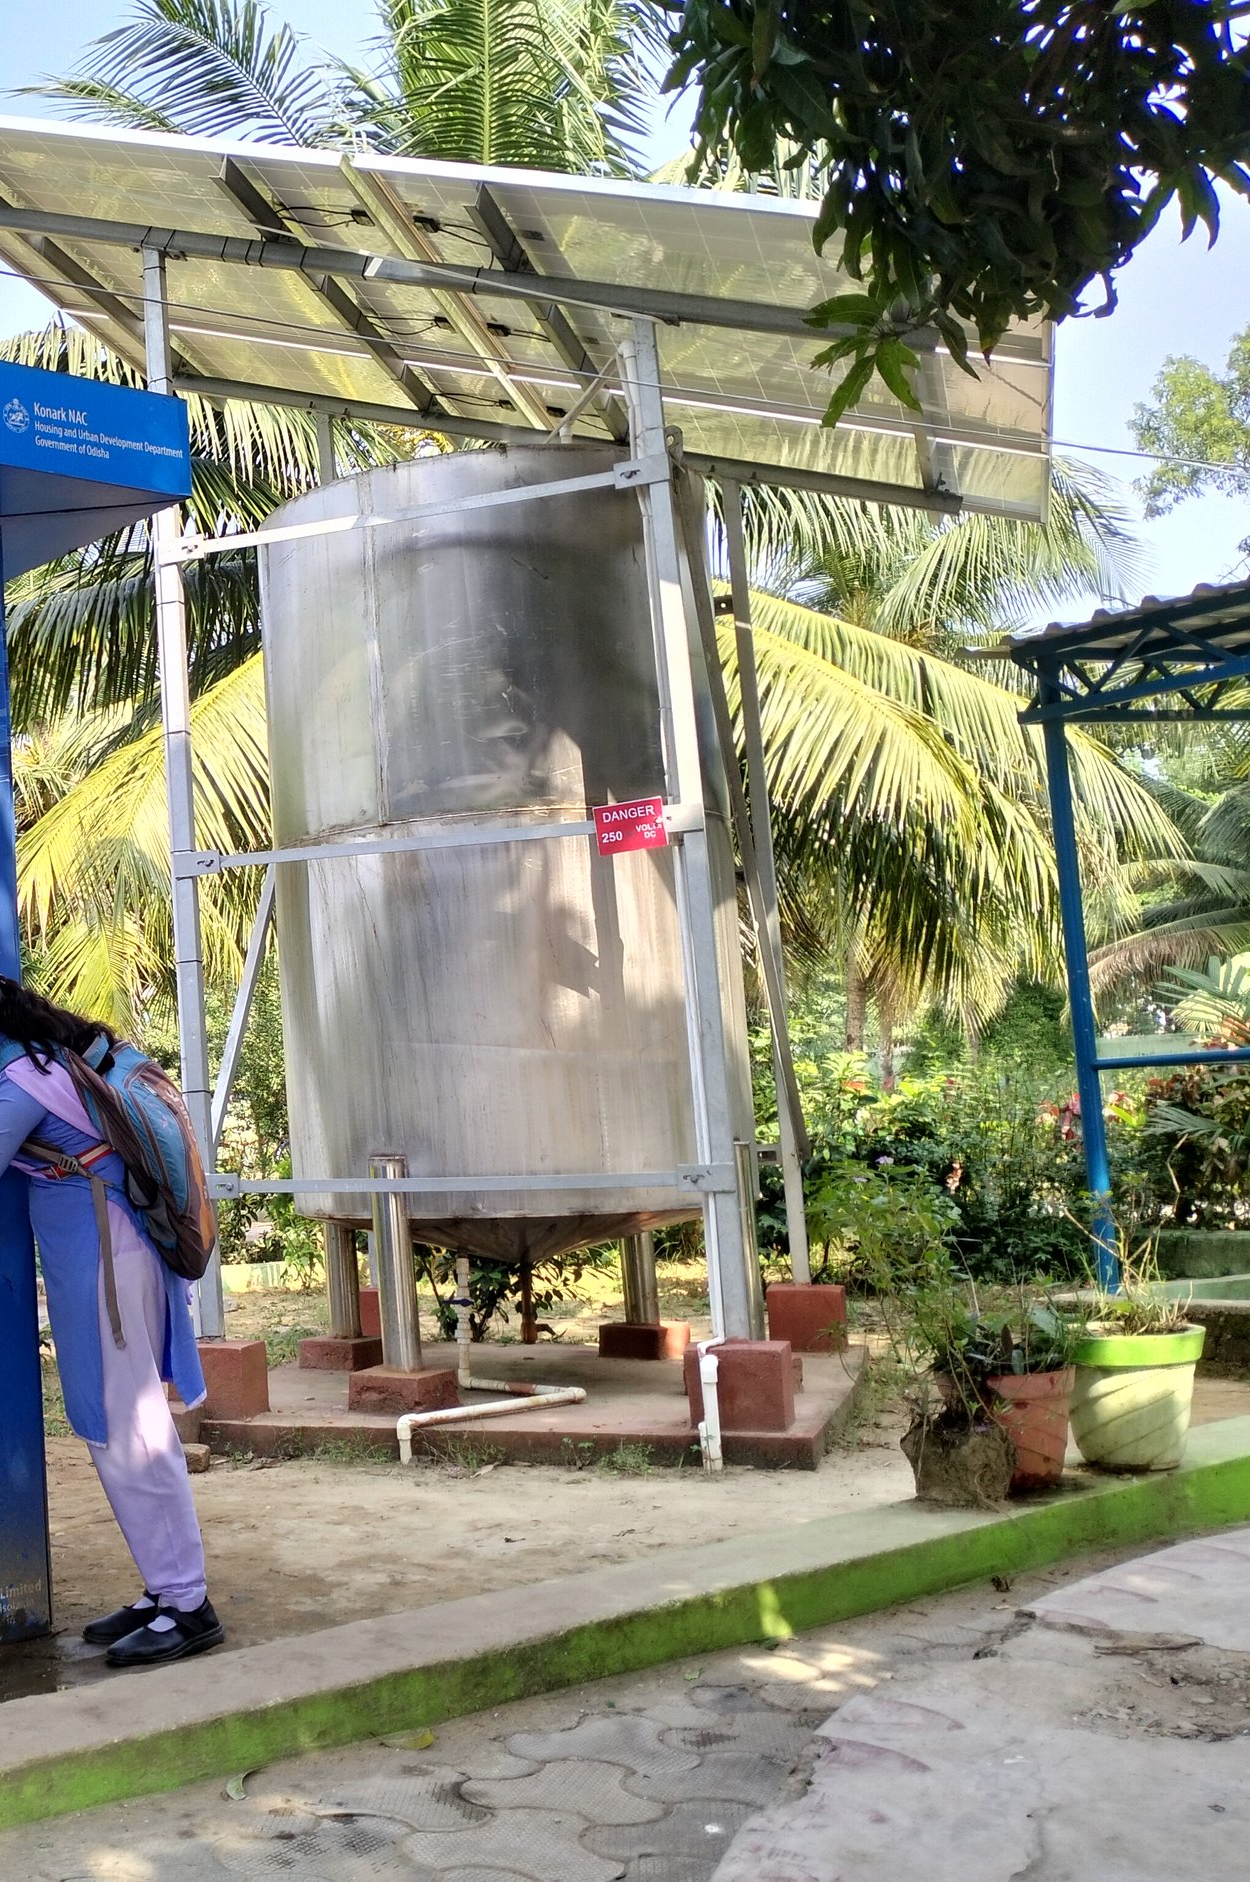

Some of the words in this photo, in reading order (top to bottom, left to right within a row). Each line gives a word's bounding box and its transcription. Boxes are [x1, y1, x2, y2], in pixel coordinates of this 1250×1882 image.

[33, 402, 67, 422] Konark
[68, 409, 88, 426] NAC
[34, 421, 62, 437] Housing
[64, 427, 77, 438] and
[78, 428, 99, 443] Urban
[100, 432, 143, 451] Development
[145, 441, 184, 459] Department
[35, 435, 77, 454] Government
[79, 444, 86, 454] of
[87, 444, 110, 459] Odisha
[602, 805, 655, 823] DANGER
[602, 831, 623, 843] 250
[0, 1579, 42, 1599] Limited
